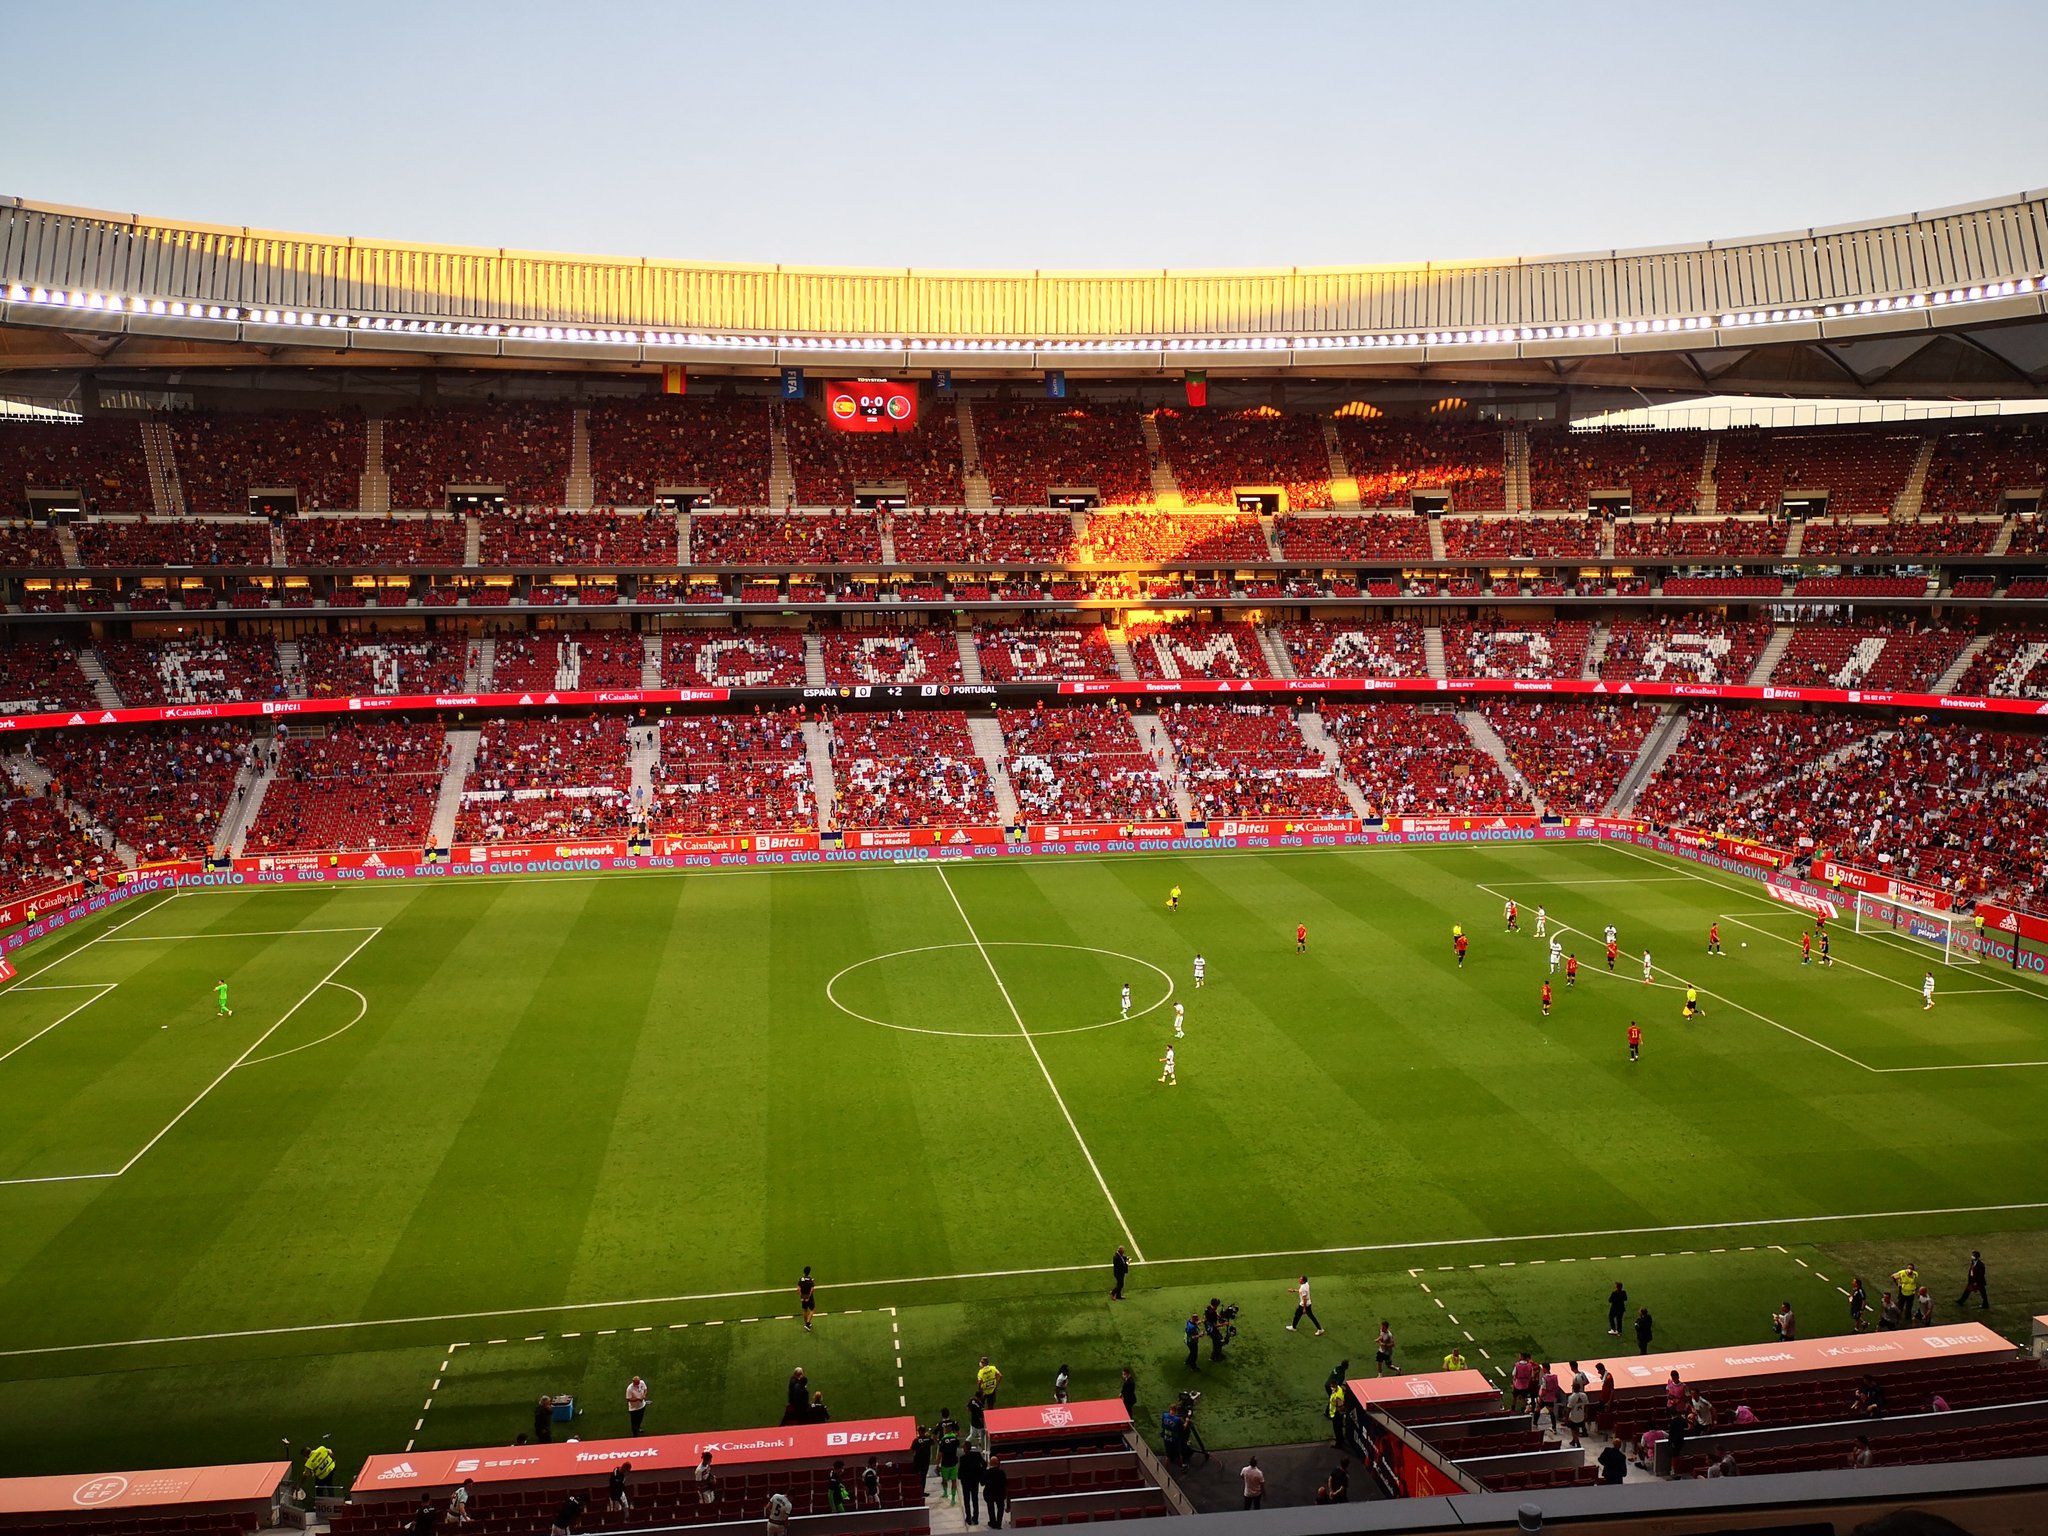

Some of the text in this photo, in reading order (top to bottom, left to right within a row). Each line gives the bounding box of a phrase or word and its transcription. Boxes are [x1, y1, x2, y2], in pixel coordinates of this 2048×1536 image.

[787, 370, 799, 394] FIFA
[1146, 683, 1182, 691] finetwork
[1304, 681, 1327, 689] CaixaBank
[1514, 682, 1553, 690] finetwork
[803, 686, 837, 697] ESPAÑA
[887, 687, 903, 696] +2
[953, 685, 998, 694] PORTUGAL
[1684, 685, 1718, 696] CaixaBank
[436, 697, 477, 705] finetwork
[608, 692, 640, 701] CaixaBank
[1940, 697, 1987, 709] finetwork
[176, 707, 213, 718] CaixaBank
[1119, 826, 1172, 837] fietwork
[1305, 822, 1347, 832] CaixaBank
[1577, 827, 1599, 836] avlo
[874, 832, 911, 840] Comunidad
[1063, 829, 1099, 837] SEAT
[1376, 832, 1401, 842] avlo
[1408, 831, 1434, 842] avlo
[1440, 830, 1467, 841] avlo
[1545, 828, 1565, 837] avlo
[1611, 830, 1632, 840] avlo
[874, 837, 910, 846] de Madrid
[1248, 836, 1269, 846] avlo
[1280, 835, 1302, 845] avlo
[1313, 834, 1335, 844] avlo
[1345, 833, 1368, 843] avlo
[1637, 836, 1653, 846] avlo
[683, 840, 729, 851] CaixaBank
[1008, 843, 1031, 853] avlo
[1041, 843, 1066, 852] avlo
[1074, 841, 1100, 851] avlo
[1107, 840, 1135, 850] avlo
[1140, 838, 1168, 849] avlo
[1658, 842, 1675, 852] avlo
[491, 850, 531, 858] SEAT
[555, 844, 614, 858] fietwork
[826, 849, 856, 860] avlo
[941, 846, 962, 856] avlo
[974, 845, 996, 854] avlo
[1679, 846, 1698, 859] avlo
[275, 856, 318, 865] Comunidad
[650, 856, 673, 866] avlo
[685, 855, 710, 865] avlo
[721, 853, 747, 864] avlo
[756, 852, 783, 863] avlo
[791, 851, 820, 862] avlo
[1701, 852, 1720, 867] avlo
[490, 861, 523, 873] avlo
[613, 858, 636, 867] avlo
[337, 868, 364, 878] avlo
[376, 866, 404, 876] avlo
[415, 864, 444, 875] avlo
[452, 863, 484, 874] avlo
[258, 872, 283, 881] avlo
[298, 870, 324, 879] avlo
[131, 878, 158, 895] avlo
[1776, 877, 1792, 888] avlo
[109, 888, 128, 902] avlo
[1800, 884, 1818, 896] avlo
[1826, 891, 1845, 904] avlo
[90, 897, 106, 910] avlo
[69, 906, 86, 919] avlo
[1880, 907, 1904, 924] avo
[49, 915, 64, 928] avlo
[29, 924, 43, 937] avlo
[9, 935, 22, 947] avlo
[1651, 1362, 1696, 1372] SEAT
[1725, 1352, 1795, 1366] finetwork
[1841, 1343, 1896, 1355] CaixaBank
[377, 1471, 418, 1480] adidas
[484, 1457, 540, 1468] SEAT
[576, 1447, 659, 1462] finetwork
[722, 1438, 785, 1450] CaixaBank
